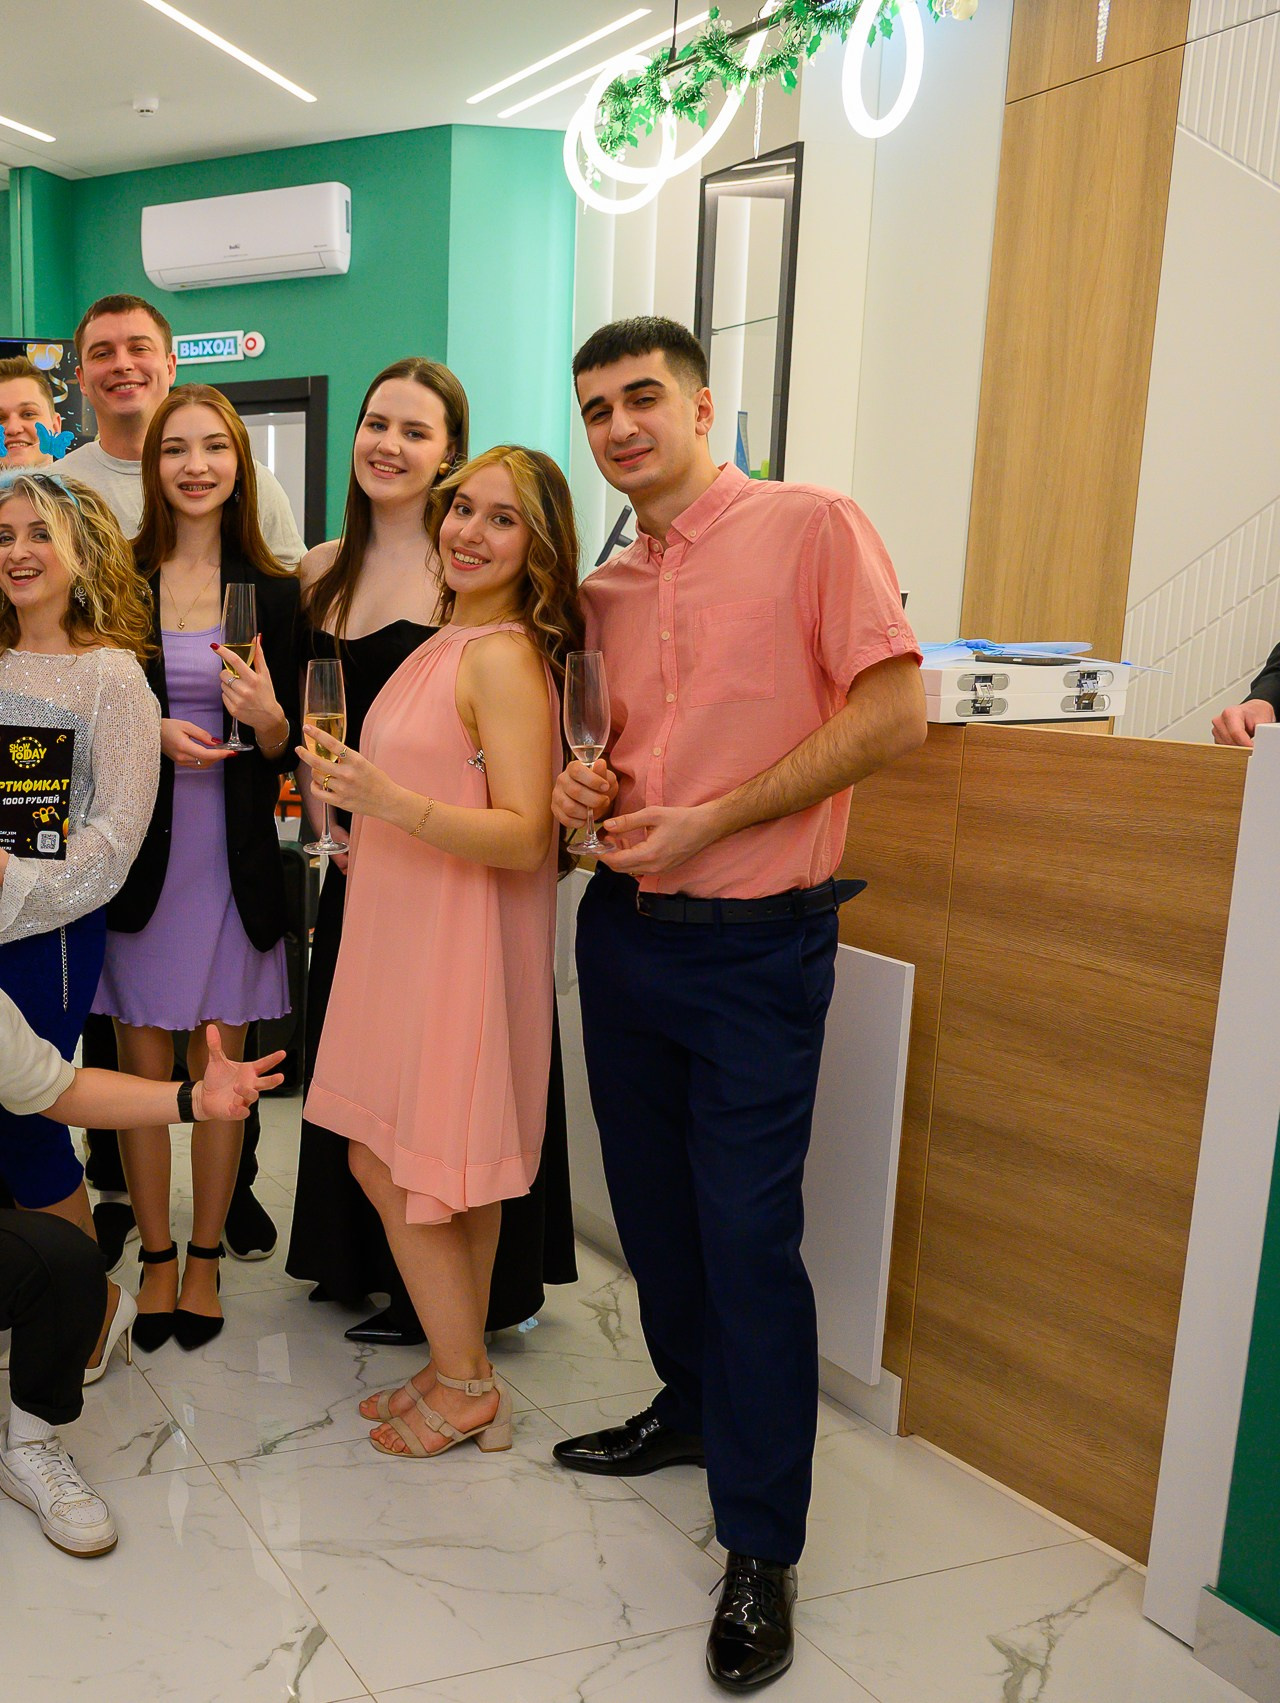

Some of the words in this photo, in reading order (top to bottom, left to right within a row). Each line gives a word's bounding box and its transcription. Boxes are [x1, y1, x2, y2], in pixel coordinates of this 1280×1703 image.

[180, 338, 235, 357] ВЫХОД
[9, 743, 31, 752] SHOW
[9, 747, 47, 761] TODAY
[2, 796, 24, 806] 1000
[25, 794, 60, 805] РУБЛЕЙ
